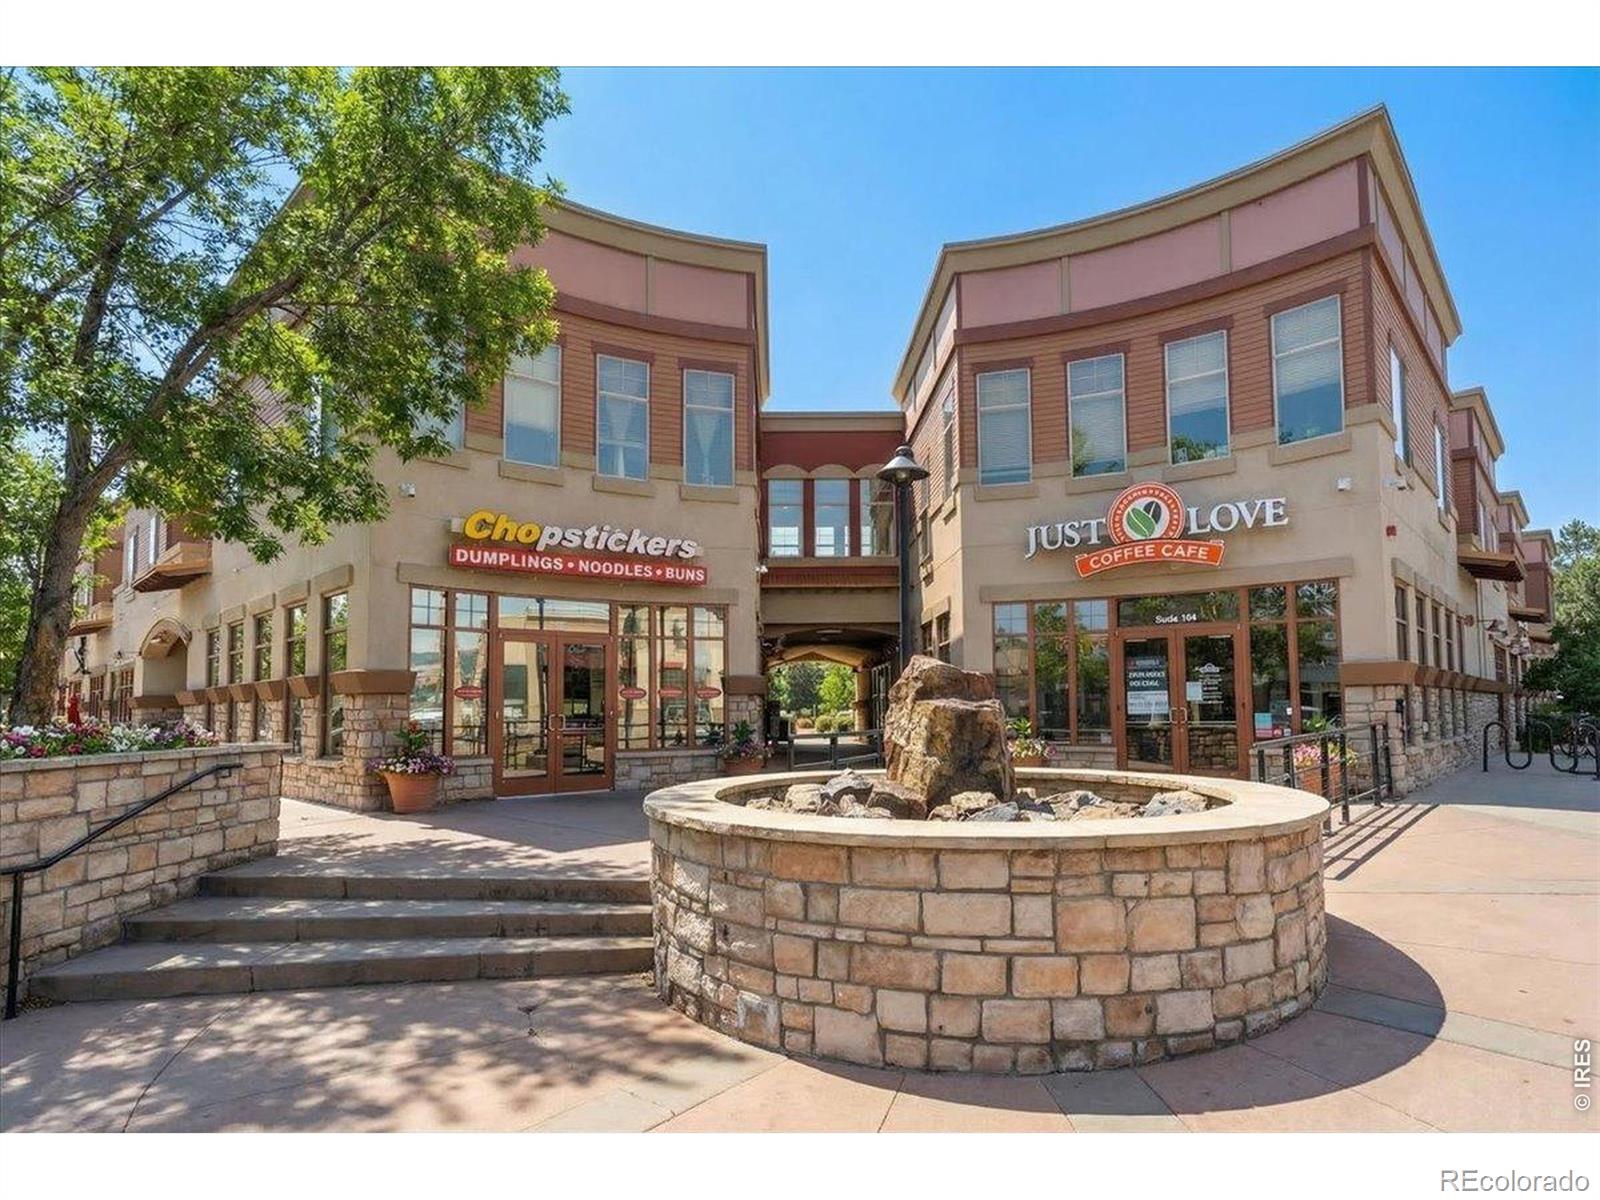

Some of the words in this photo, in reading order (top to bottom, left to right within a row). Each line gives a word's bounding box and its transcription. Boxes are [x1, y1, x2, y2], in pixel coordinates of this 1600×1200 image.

[464, 509, 699, 559] Chopstickers
[1025, 518, 1106, 560] JUST
[1187, 497, 1289, 535] LOVE
[456, 548, 564, 571] DUMPLINGS
[579, 560, 653, 578] NOODLES
[665, 567, 705, 582] BUNS
[1089, 544, 1155, 570] COFFEE
[1161, 543, 1209, 560] CAFE
